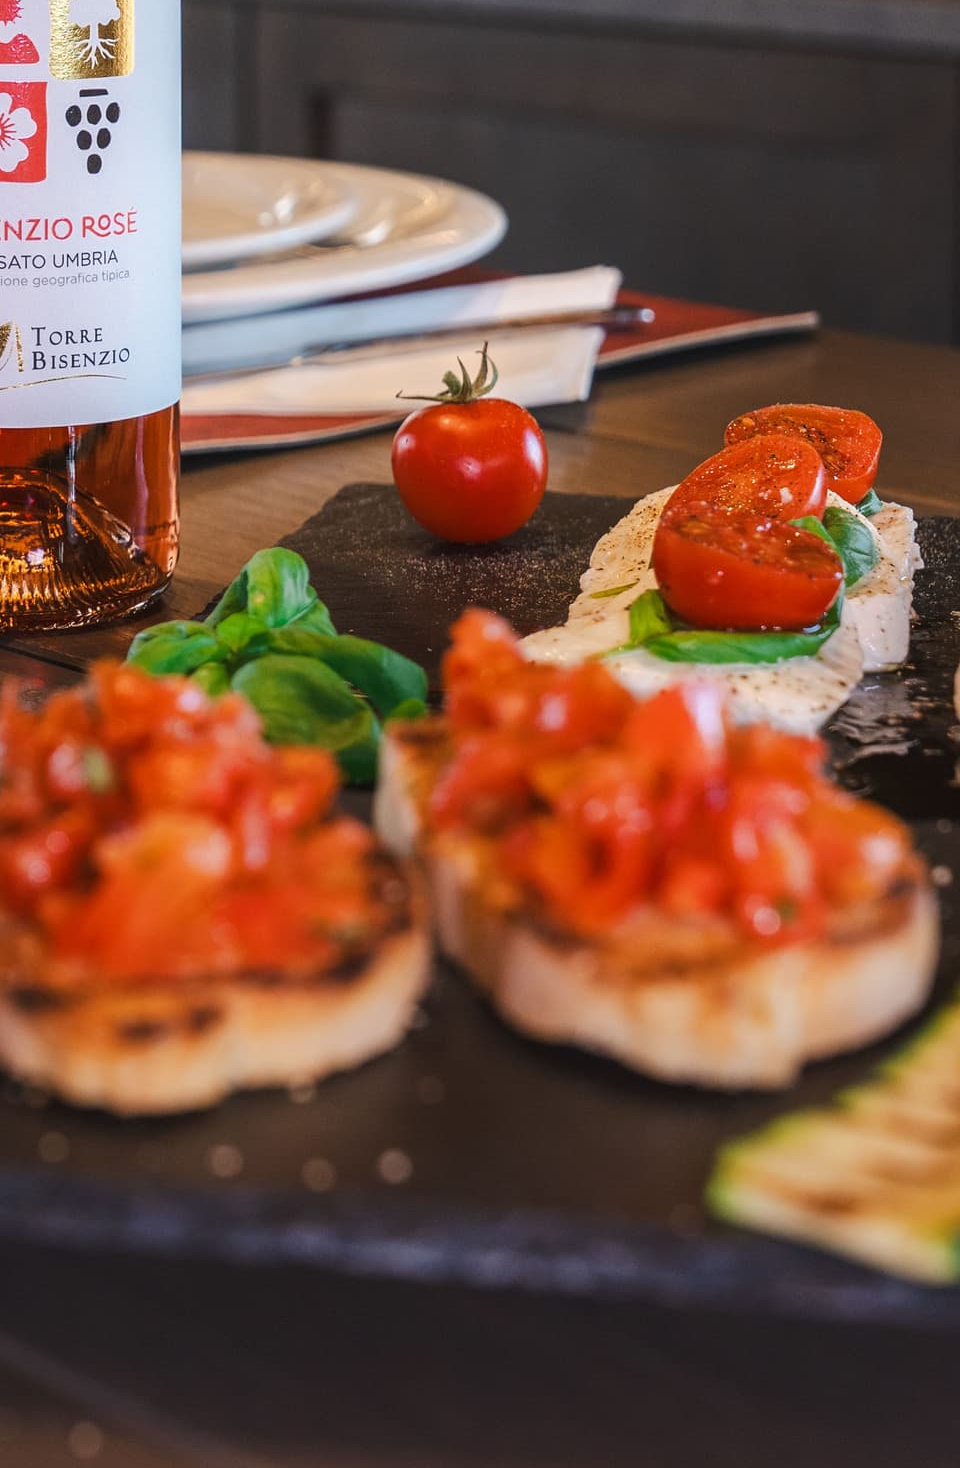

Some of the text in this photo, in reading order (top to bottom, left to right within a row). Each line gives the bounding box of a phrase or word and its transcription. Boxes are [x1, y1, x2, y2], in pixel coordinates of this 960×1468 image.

[52, 249, 119, 269] UMBRIA
[32, 271, 98, 288] geografica
[102, 269, 130, 284] tipica
[30, 326, 103, 347] TORRE
[31, 347, 131, 371] BISENZIO
